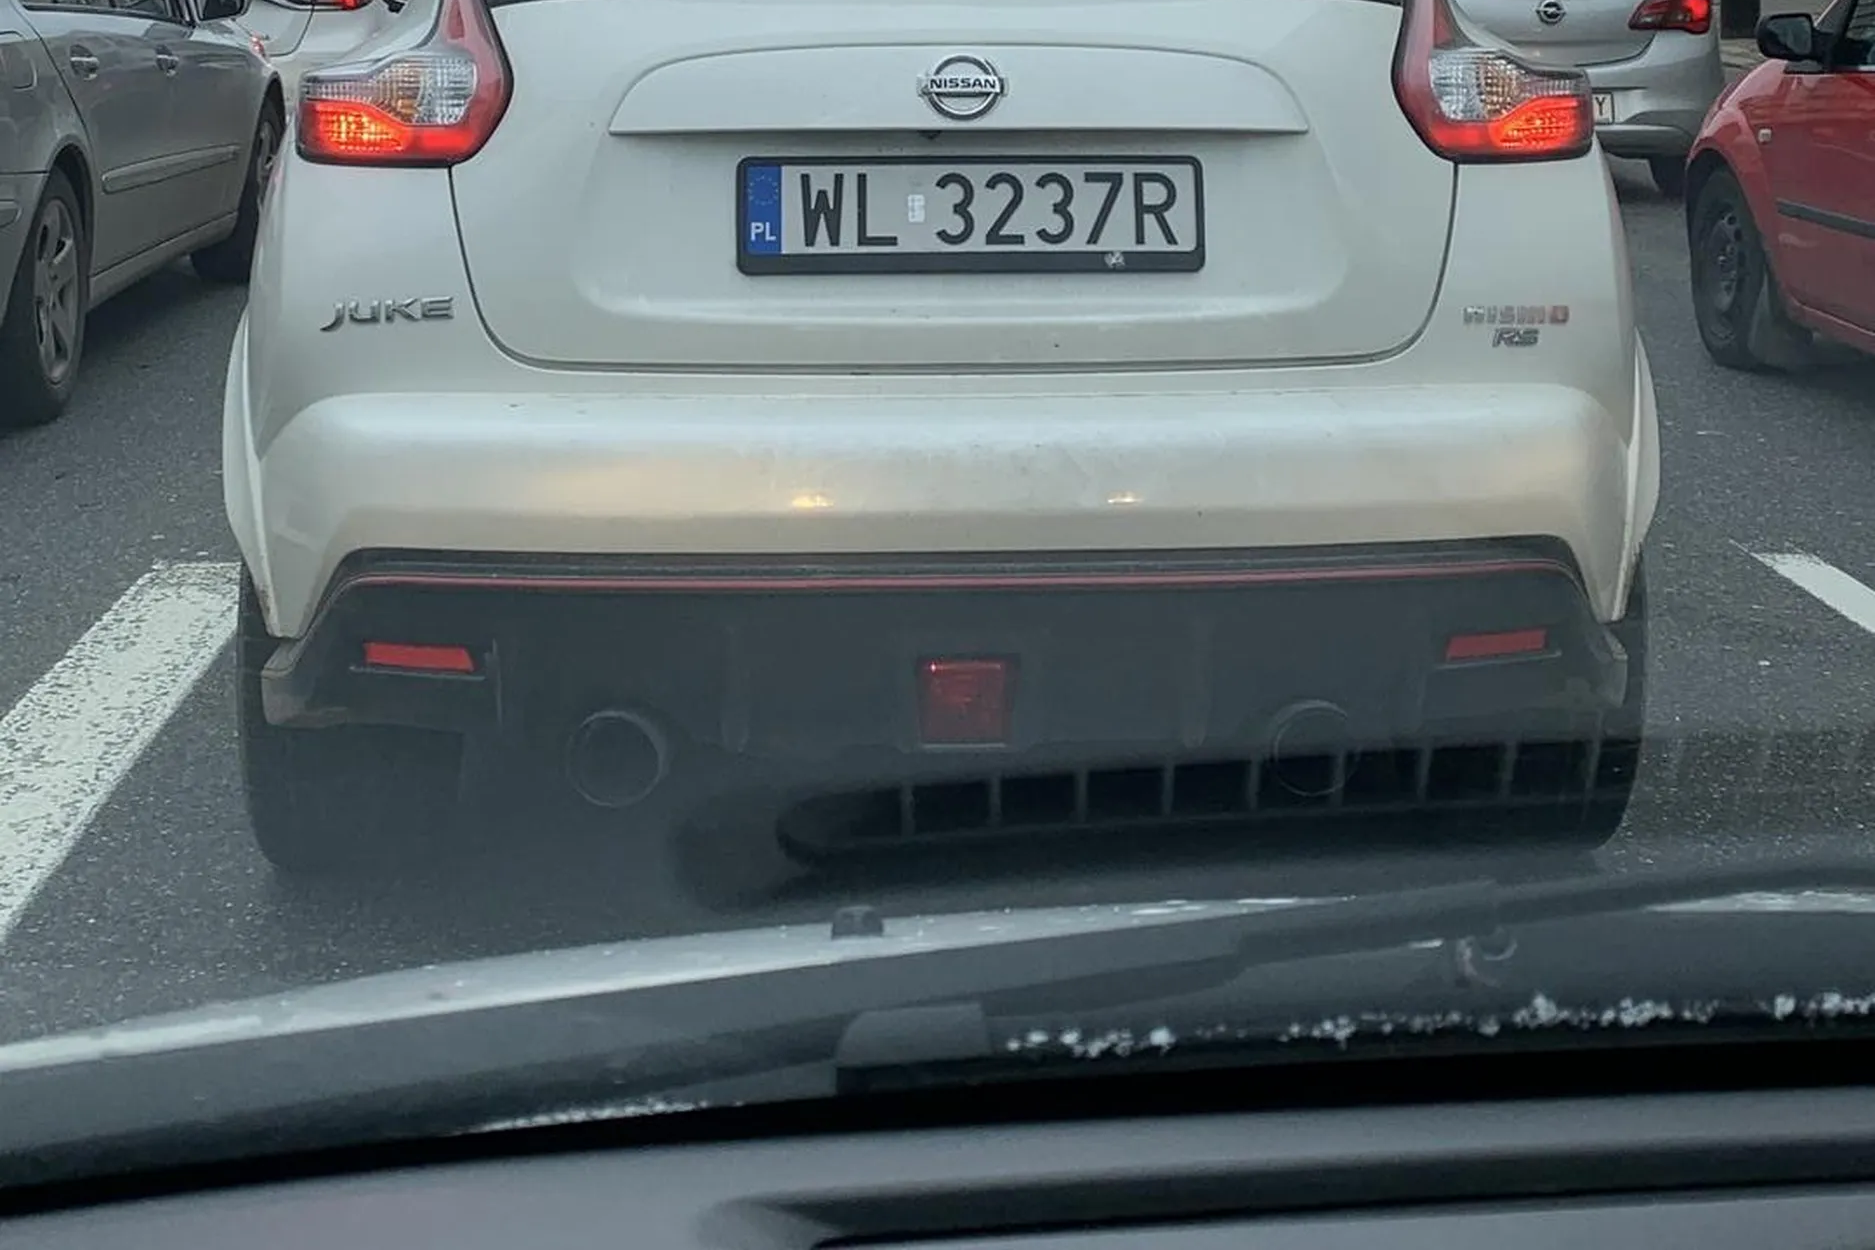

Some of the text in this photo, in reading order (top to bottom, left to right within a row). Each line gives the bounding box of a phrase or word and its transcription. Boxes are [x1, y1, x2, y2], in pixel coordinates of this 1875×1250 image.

[930, 78, 996, 89] NISSAN
[801, 172, 1179, 247] WL 3237R
[750, 222, 777, 241] PL
[320, 296, 454, 332] JUKE
[1491, 328, 1539, 348] RS
